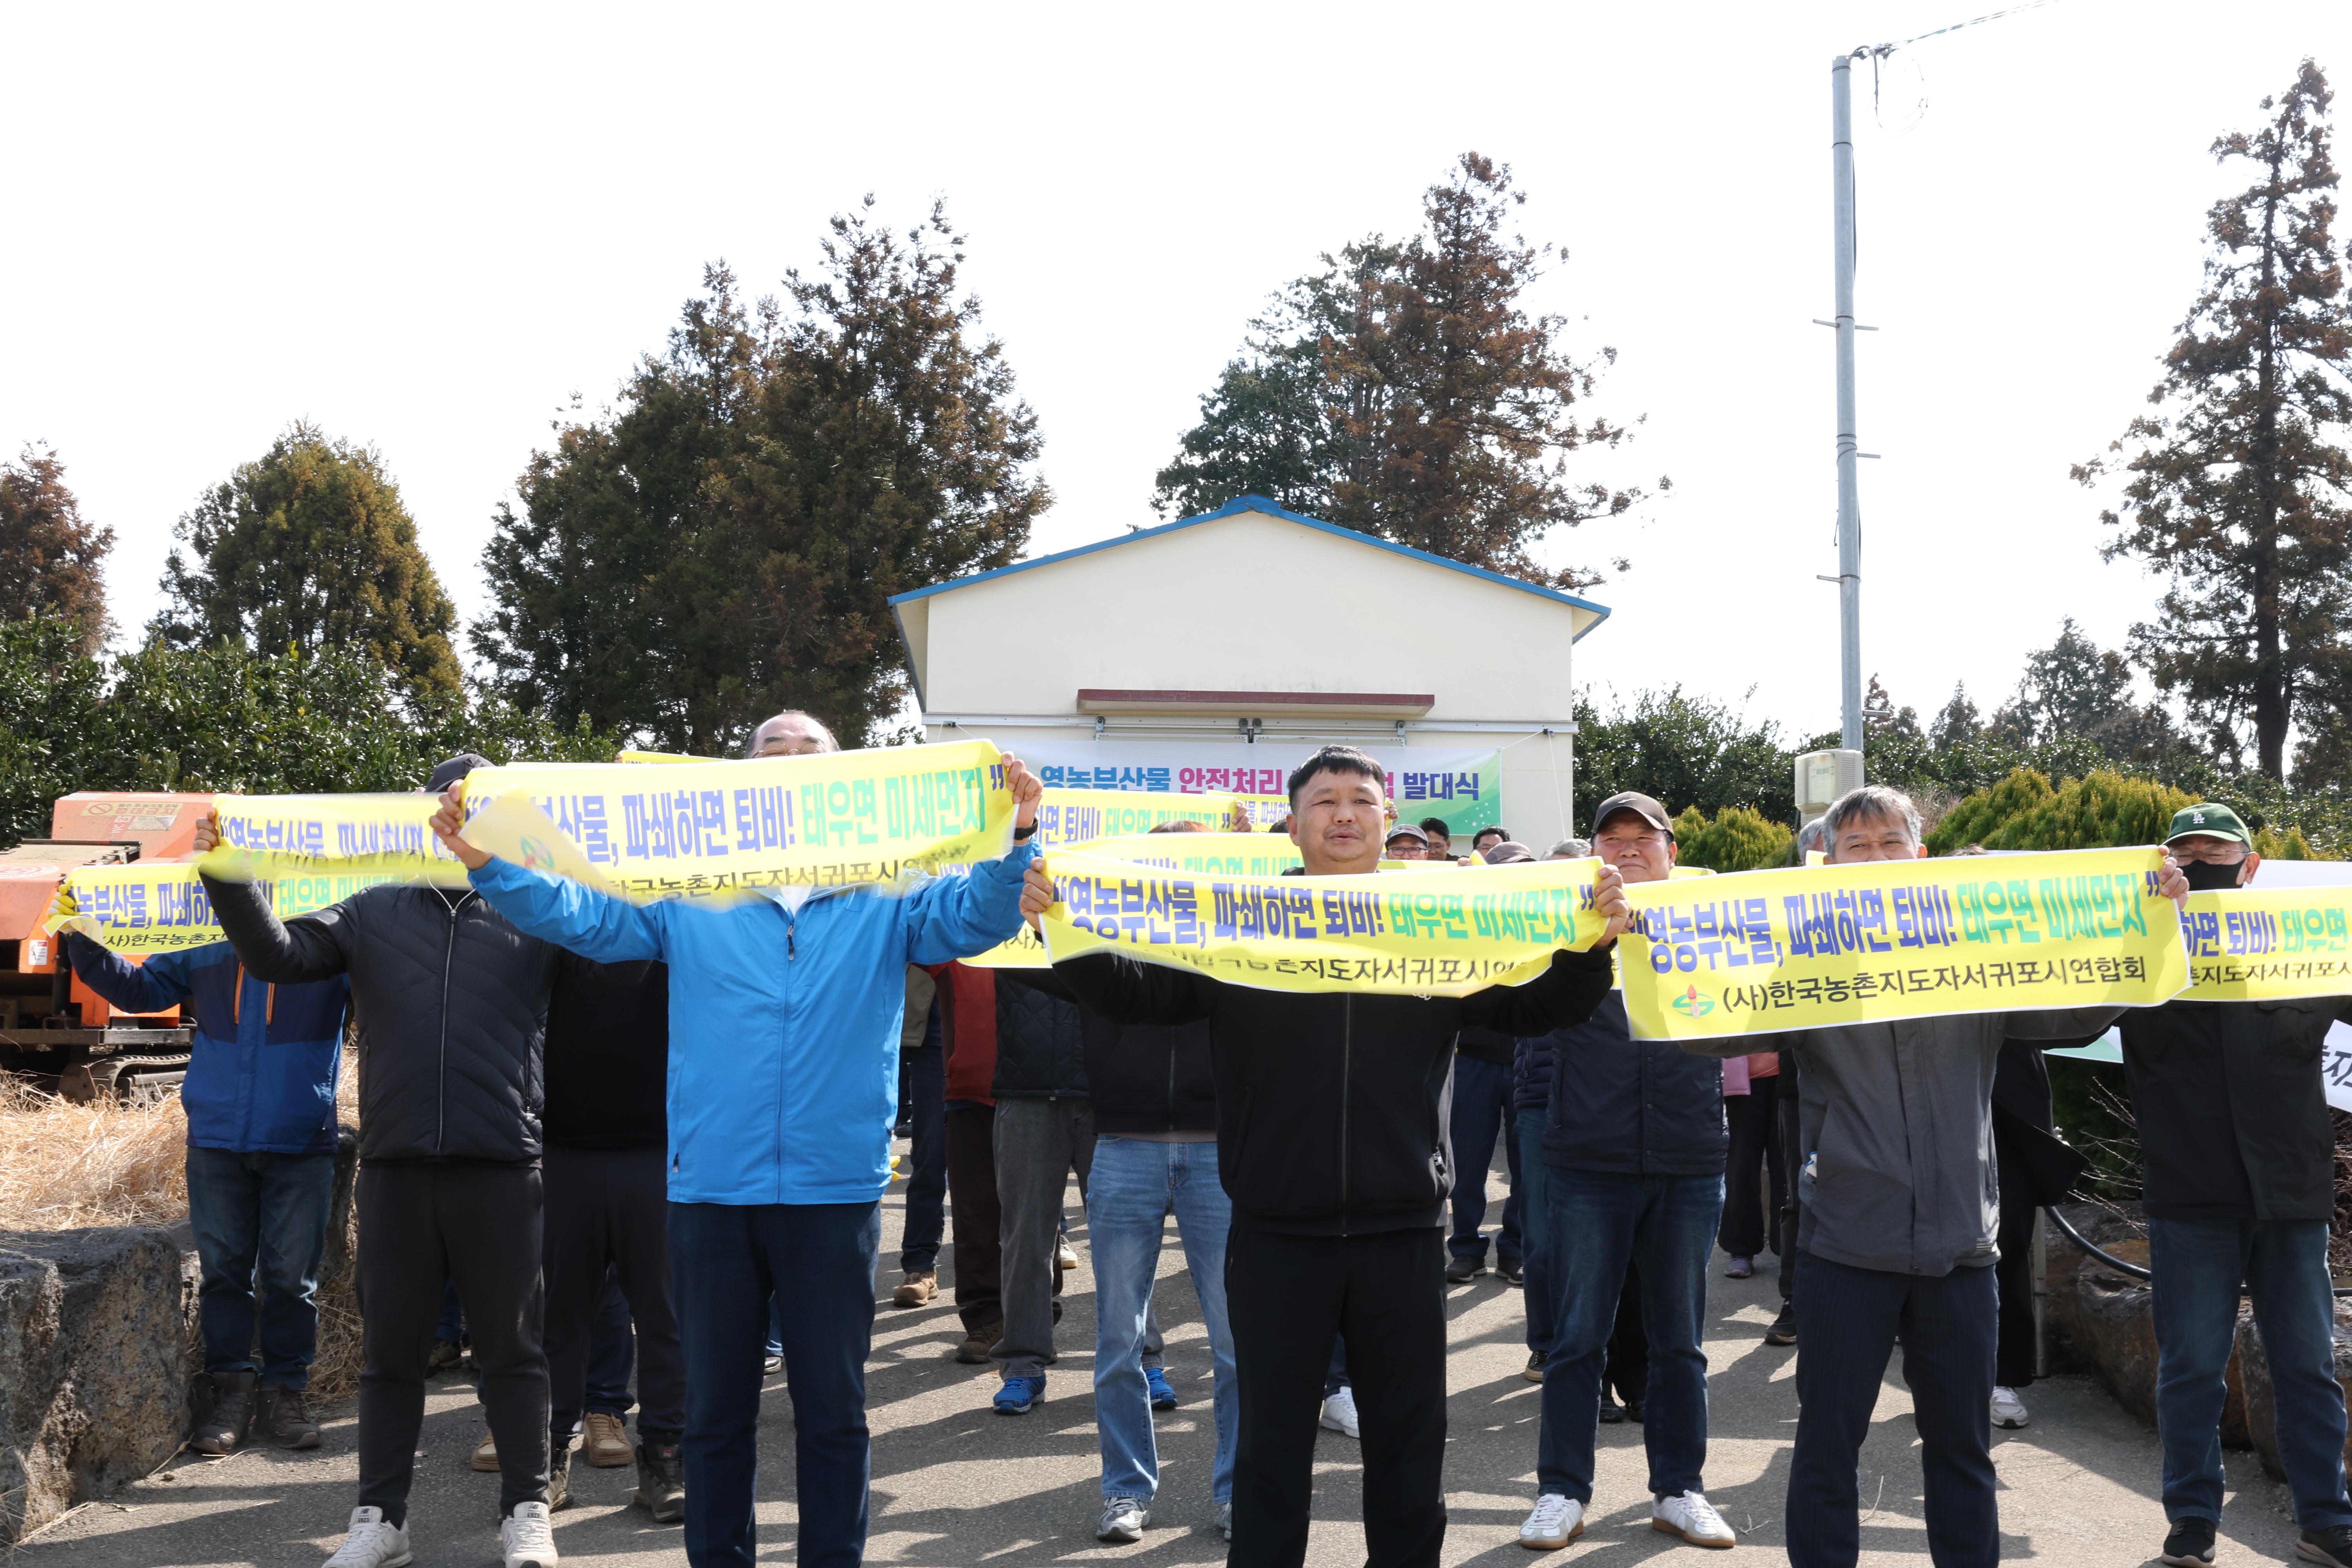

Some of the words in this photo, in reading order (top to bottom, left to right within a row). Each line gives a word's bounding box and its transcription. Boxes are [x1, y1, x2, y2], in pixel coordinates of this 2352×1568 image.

[1041, 766, 1171, 792] 영농부산물
[1179, 767, 1282, 795] 안전처리
[1403, 772, 1479, 800] 발대식
[622, 790, 729, 860] 파쇄하면
[734, 786, 795, 852] 퇴비!
[800, 778, 879, 847] 태우면
[2192, 811, 2205, 824] LA
[67, 884, 152, 930] 농부산물,
[157, 880, 221, 927] 파쇄하
[1212, 882, 1317, 941] 파쇄하면
[1323, 889, 1385, 937] 퇴비!
[1388, 893, 1468, 939] 태우면
[1783, 888, 1893, 958] 파쇄하면
[1891, 884, 1958, 949] 퇴비!
[1956, 879, 2041, 944] 태우면
[2225, 910, 2277, 955] 퇴비!
[2280, 907, 2348, 953] 태우면
[1723, 955, 2147, 1013] (사)한국농촌지도자서귀포시연합회
